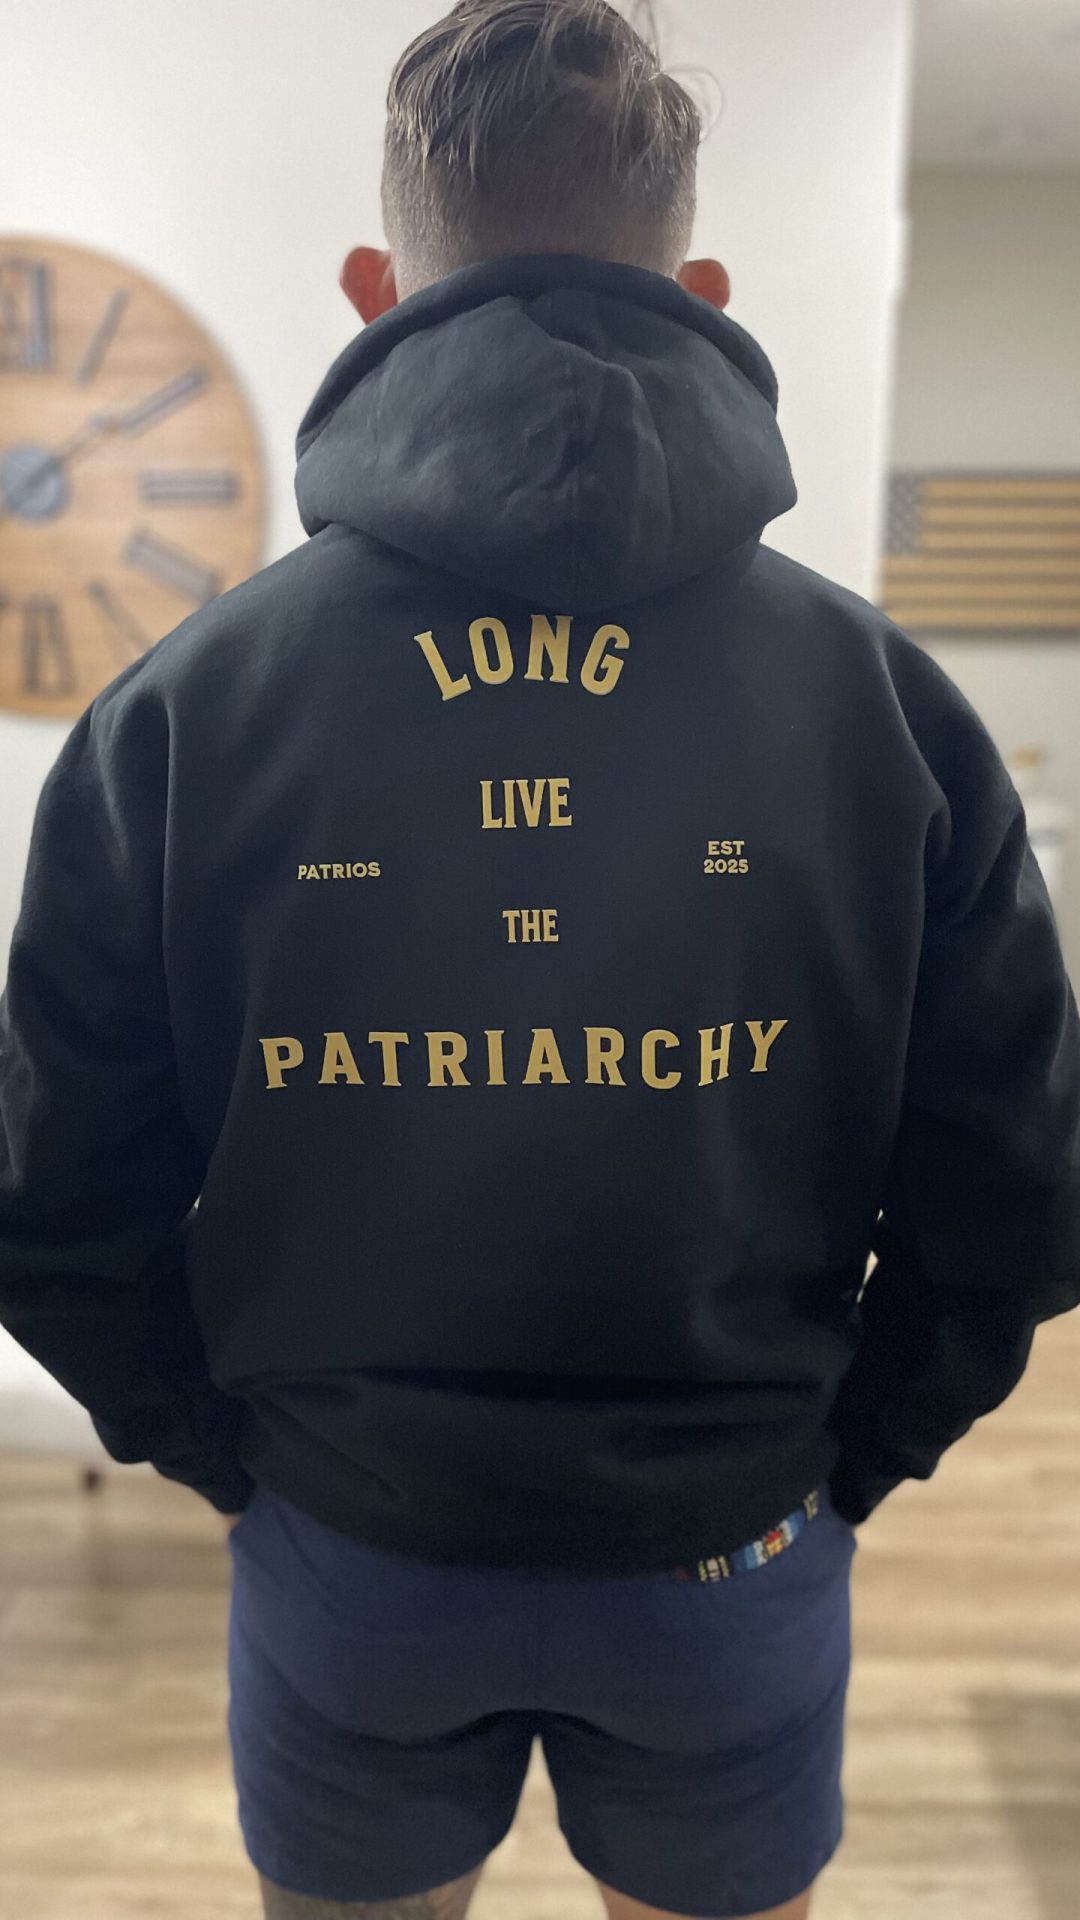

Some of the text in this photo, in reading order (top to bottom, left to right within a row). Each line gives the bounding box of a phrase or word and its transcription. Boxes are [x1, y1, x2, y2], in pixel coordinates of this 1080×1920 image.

[414, 614, 631, 701] LONG
[480, 777, 573, 829] LIVE
[706, 840, 745, 856] EST
[297, 861, 382, 880] PATRIOS
[703, 858, 749, 875] 2025
[502, 908, 560, 944] THE
[259, 1019, 788, 1090] PATRIARCHY
